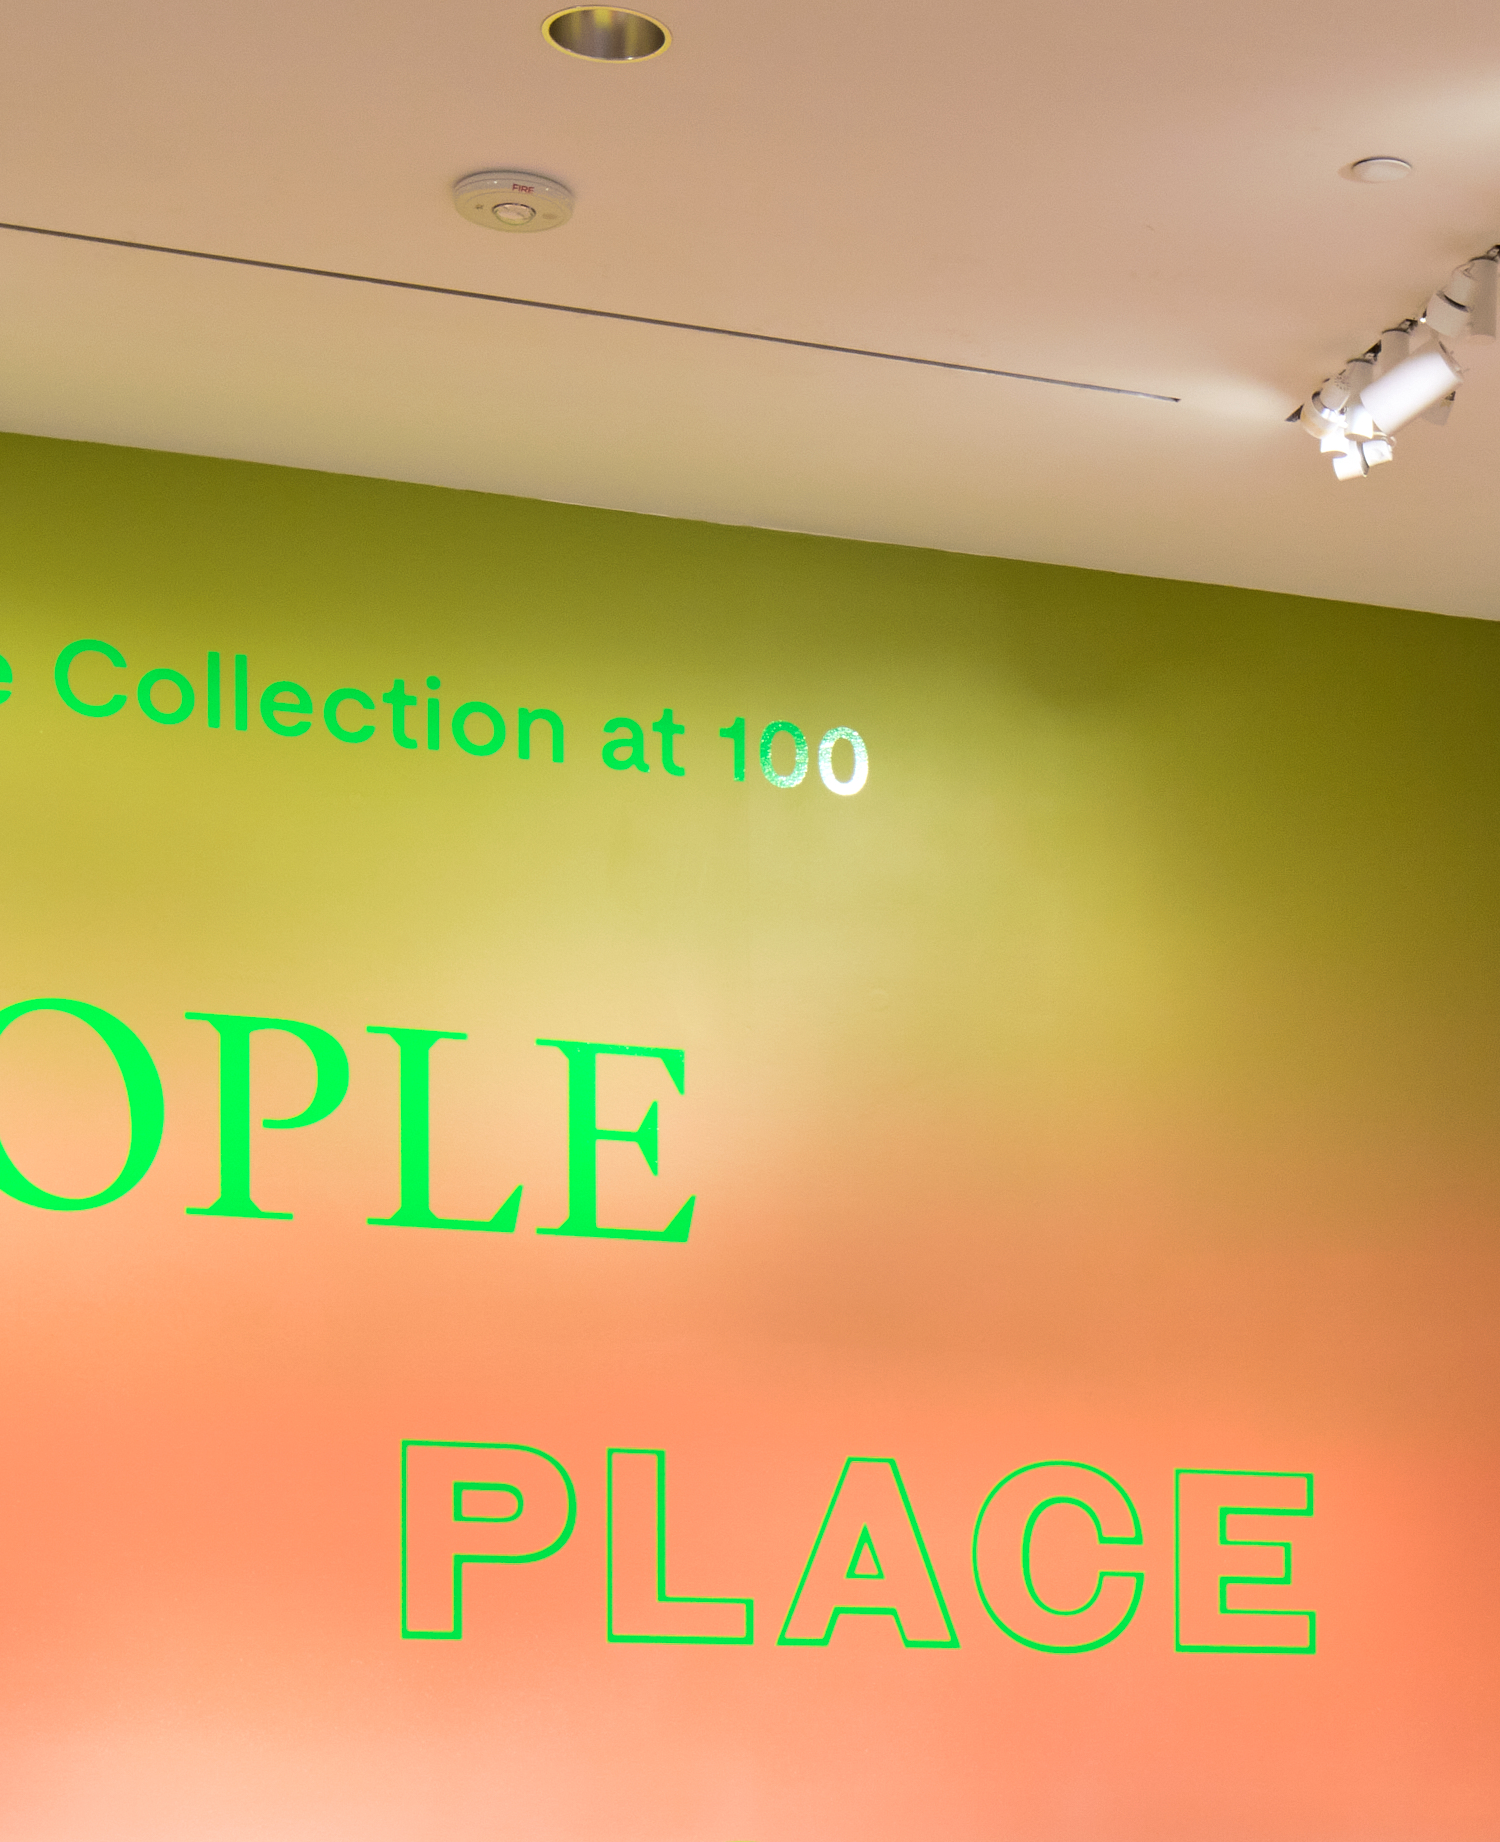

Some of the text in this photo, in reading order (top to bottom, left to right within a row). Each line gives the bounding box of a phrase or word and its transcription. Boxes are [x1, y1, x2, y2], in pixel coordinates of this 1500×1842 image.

[512, 183, 535, 194] FIRE
[54, 639, 564, 763] Collection
[602, 708, 685, 776] at
[720, 717, 869, 797] 100
[402, 1441, 1317, 1655] PLACE
